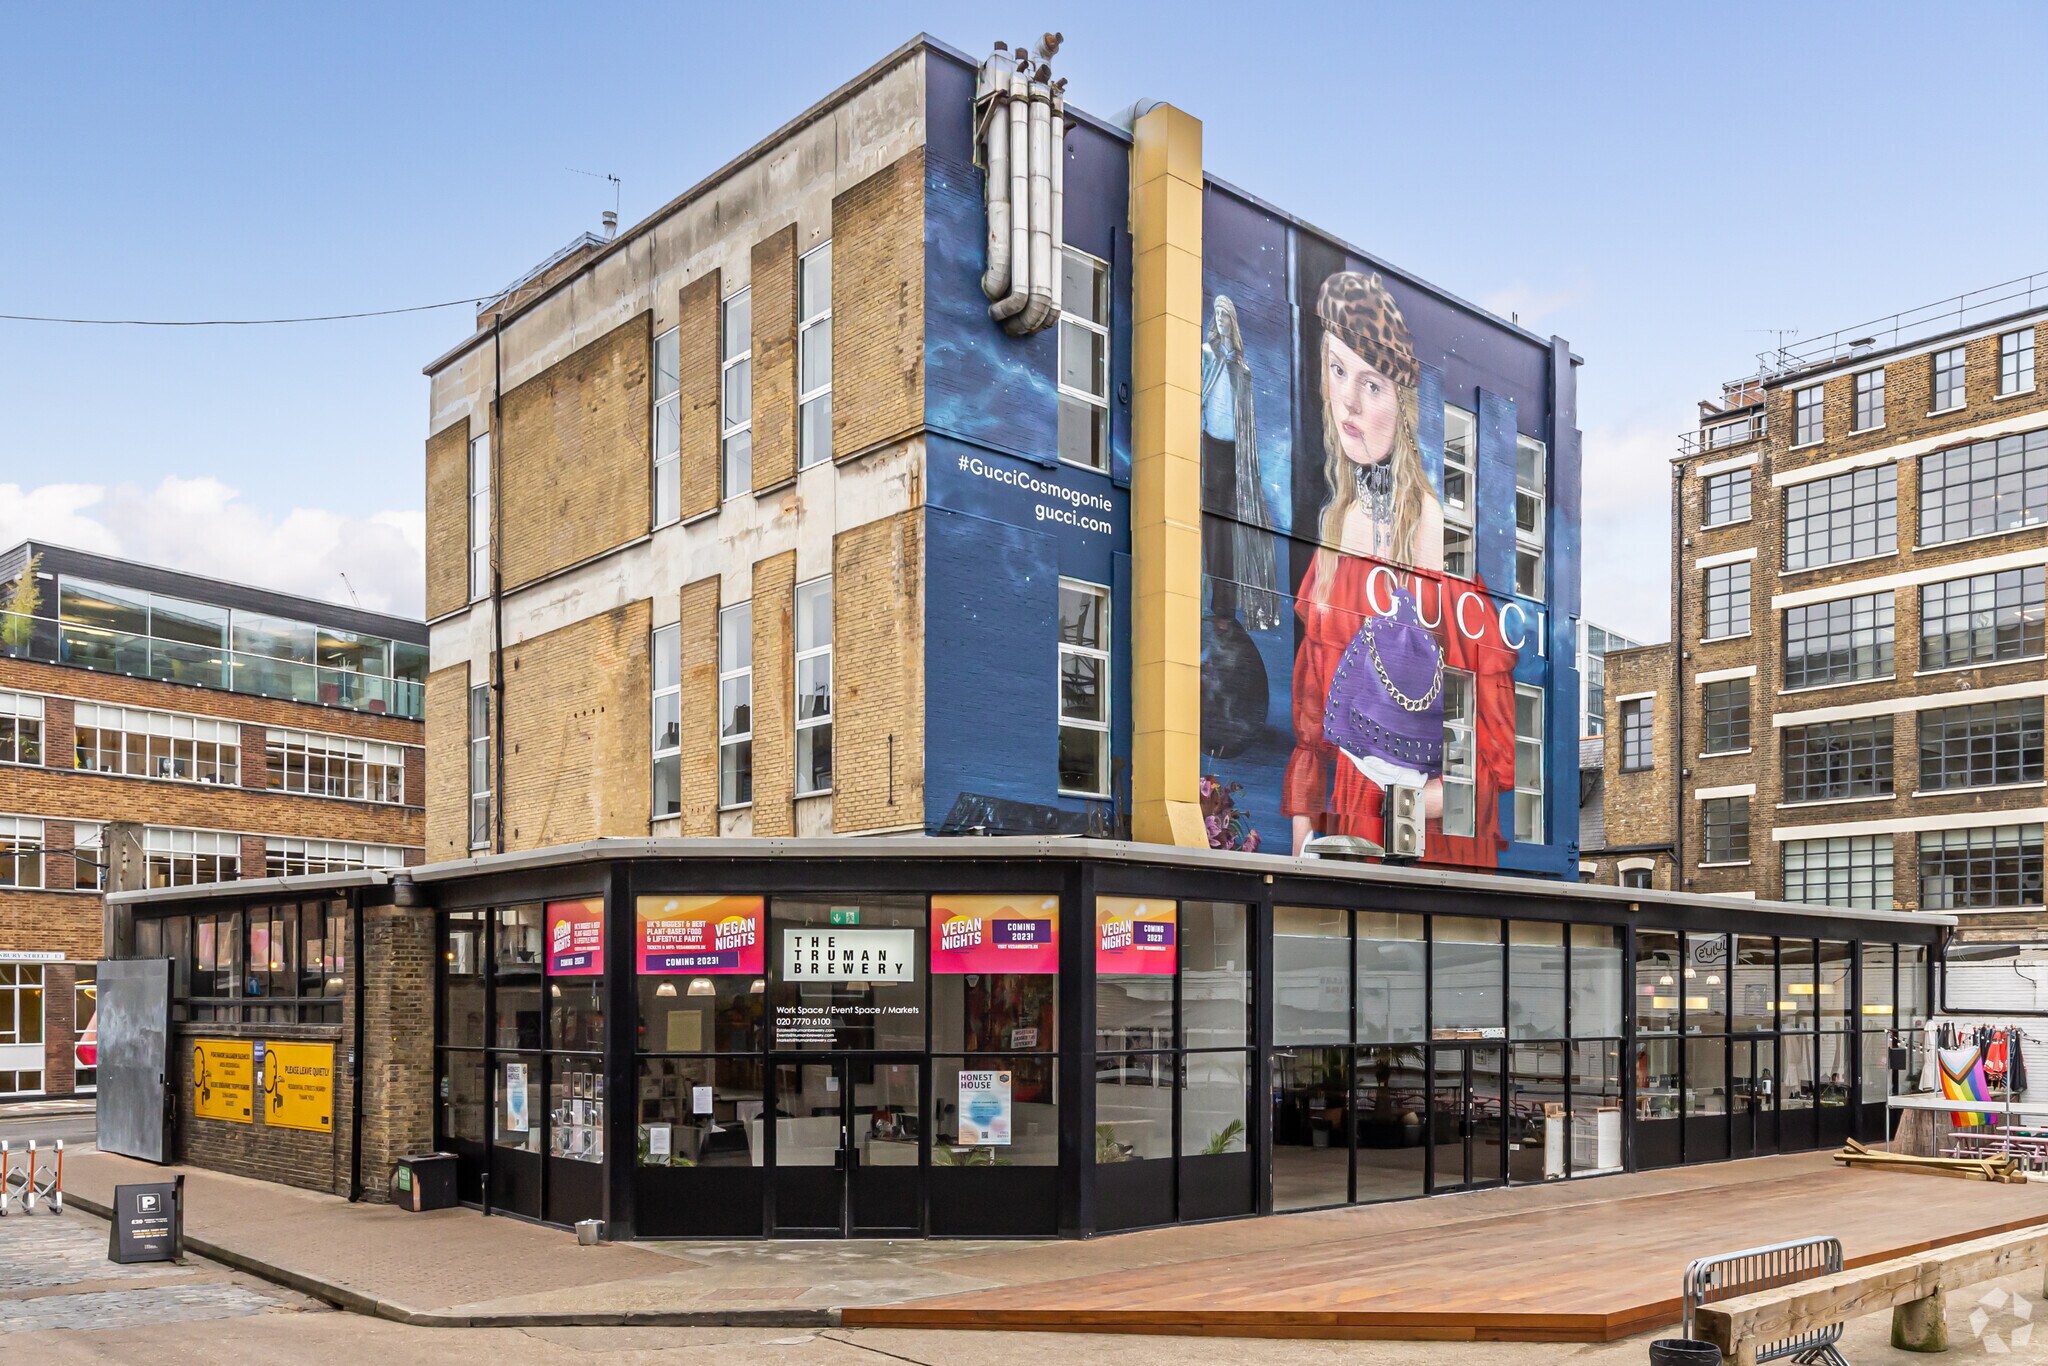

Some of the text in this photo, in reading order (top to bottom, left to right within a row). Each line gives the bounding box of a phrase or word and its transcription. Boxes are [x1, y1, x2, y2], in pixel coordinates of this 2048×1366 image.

[958, 455, 1112, 512] #GucciCosmogonie
[1035, 504, 1112, 535] gucci.com
[1366, 566, 1545, 657] GUCCI
[554, 921, 571, 941] VEGAN
[715, 918, 755, 937] VEGAN
[942, 918, 982, 936] VEGAN
[1008, 923, 1035, 931] COMING
[1102, 920, 1131, 937] VEGAN
[1144, 925, 1164, 933] COMING
[715, 932, 755, 951] NIGHTS
[795, 937, 835, 948] THE
[942, 932, 982, 950] NIGHTS
[1102, 933, 1131, 950] NIGHTS
[666, 956, 718, 967] COMING 2023!
[795, 950, 886, 961] TRUMAN
[794, 963, 903, 974] BREWERY
[776, 1006, 796, 1014] Work
[285, 1066, 330, 1077] PLEASE LEAVE QUIETLY
[142, 1196, 156, 1208] P
